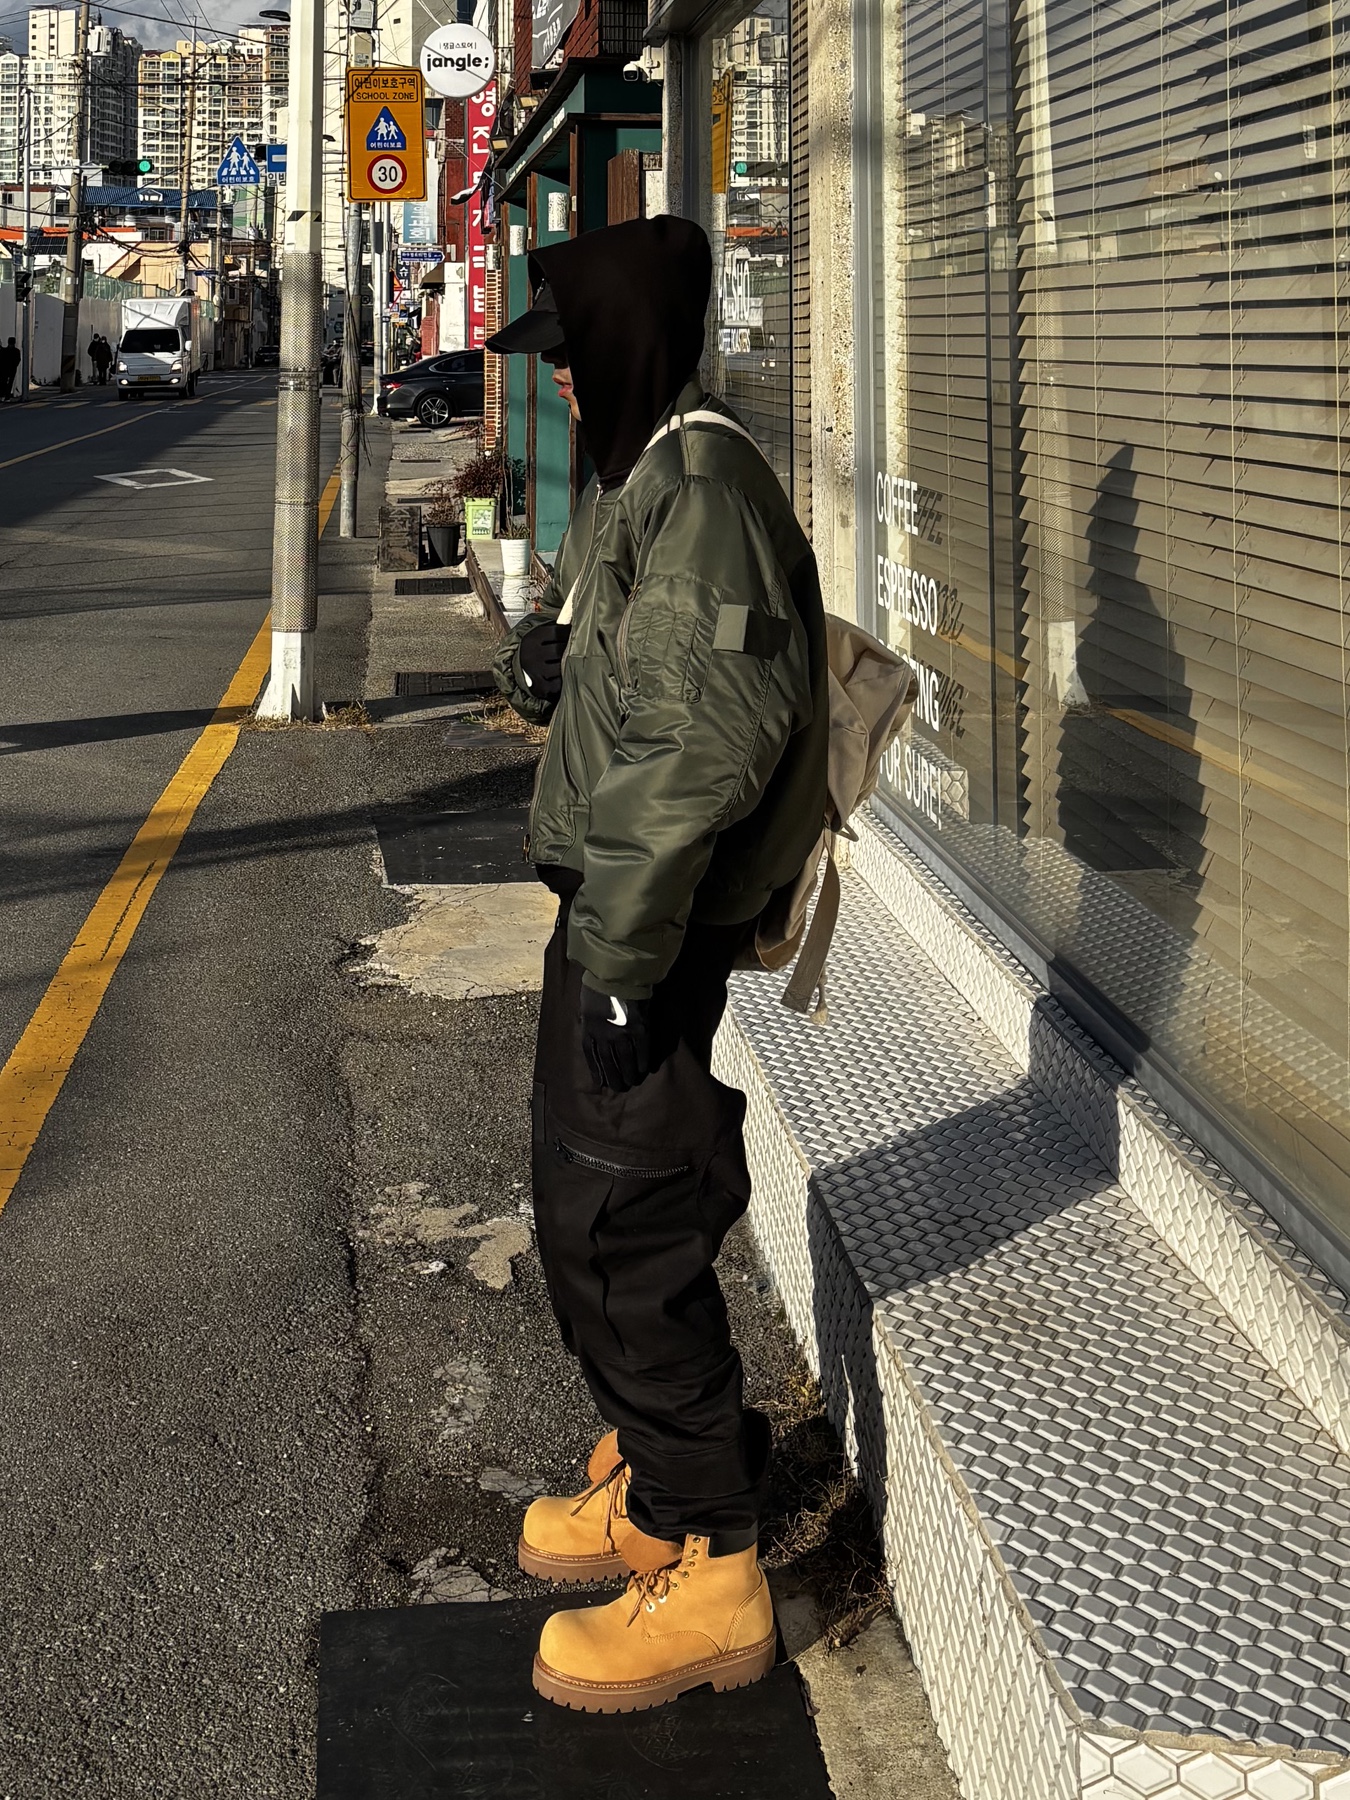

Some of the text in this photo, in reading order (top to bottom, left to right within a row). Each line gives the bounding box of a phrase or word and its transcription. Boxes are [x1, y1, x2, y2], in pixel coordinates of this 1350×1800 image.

[354, 77, 416, 89] 어린이보호구역
[356, 92, 415, 100] SCHOOL ZONE
[221, 176, 255, 184] 어린이보호
[378, 166, 398, 182] 30
[876, 471, 919, 536] COFFEE
[877, 554, 938, 636] ESPRESSO
[904, 744, 943, 831] SURE!
